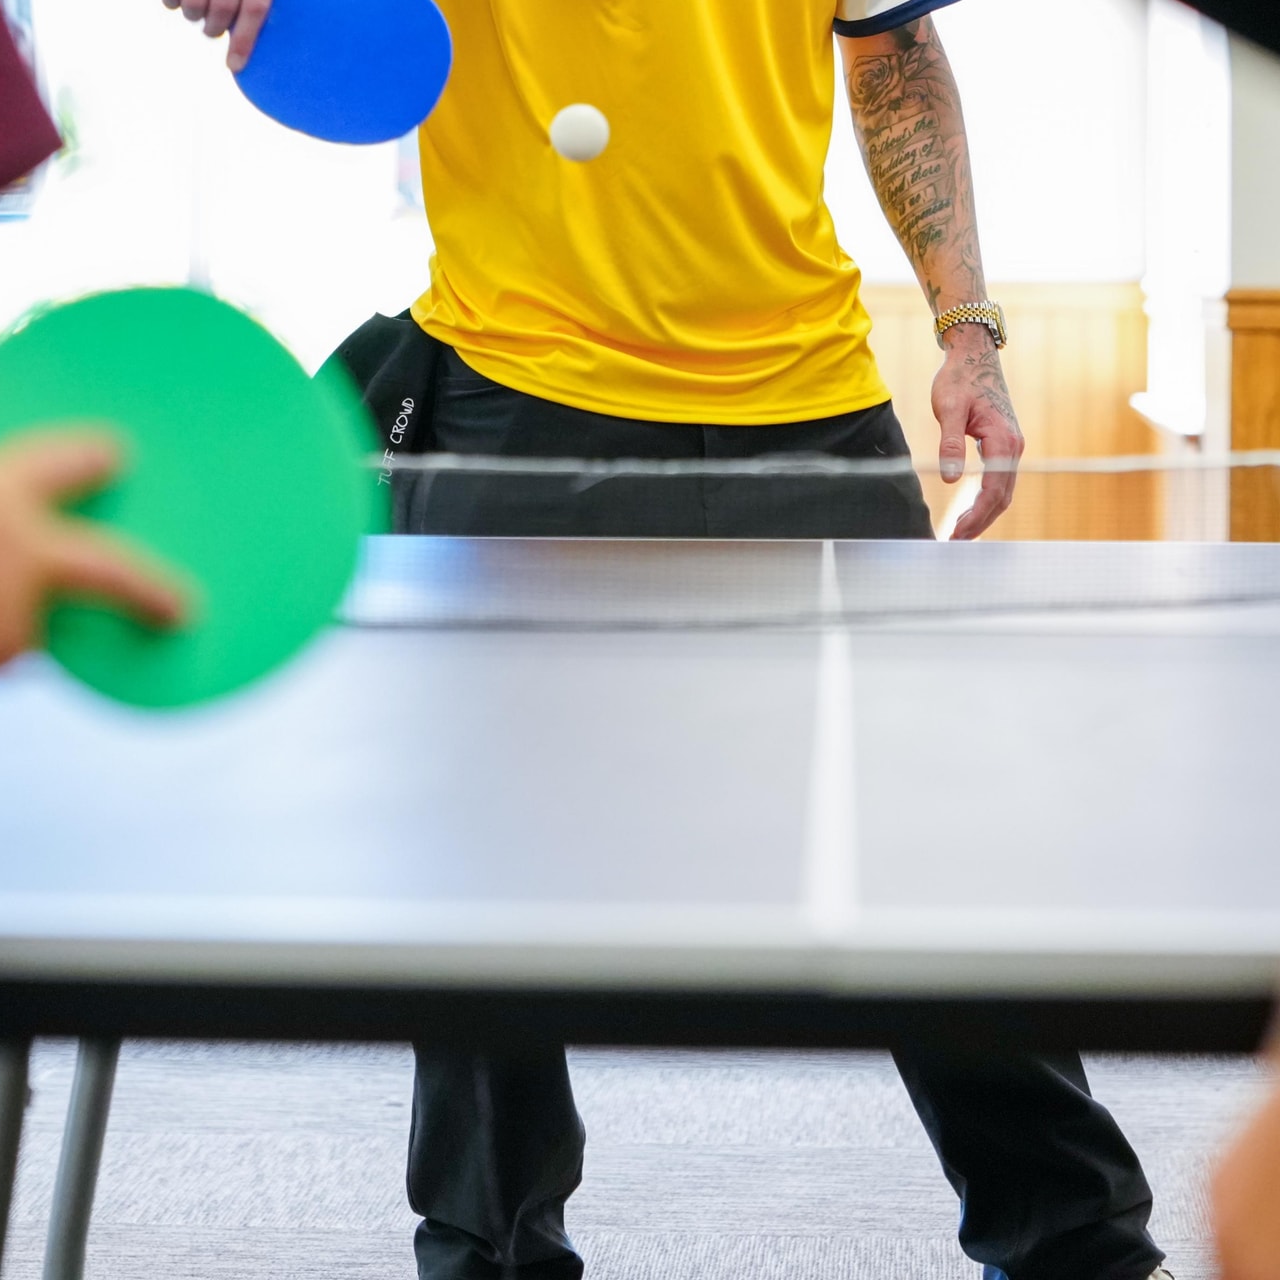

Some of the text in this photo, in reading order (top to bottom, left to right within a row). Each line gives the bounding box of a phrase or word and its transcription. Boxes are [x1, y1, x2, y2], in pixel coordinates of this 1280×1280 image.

[914, 116, 934, 134] the
[911, 166, 942, 184] there
[377, 397, 415, 486] TUFF CROWD
